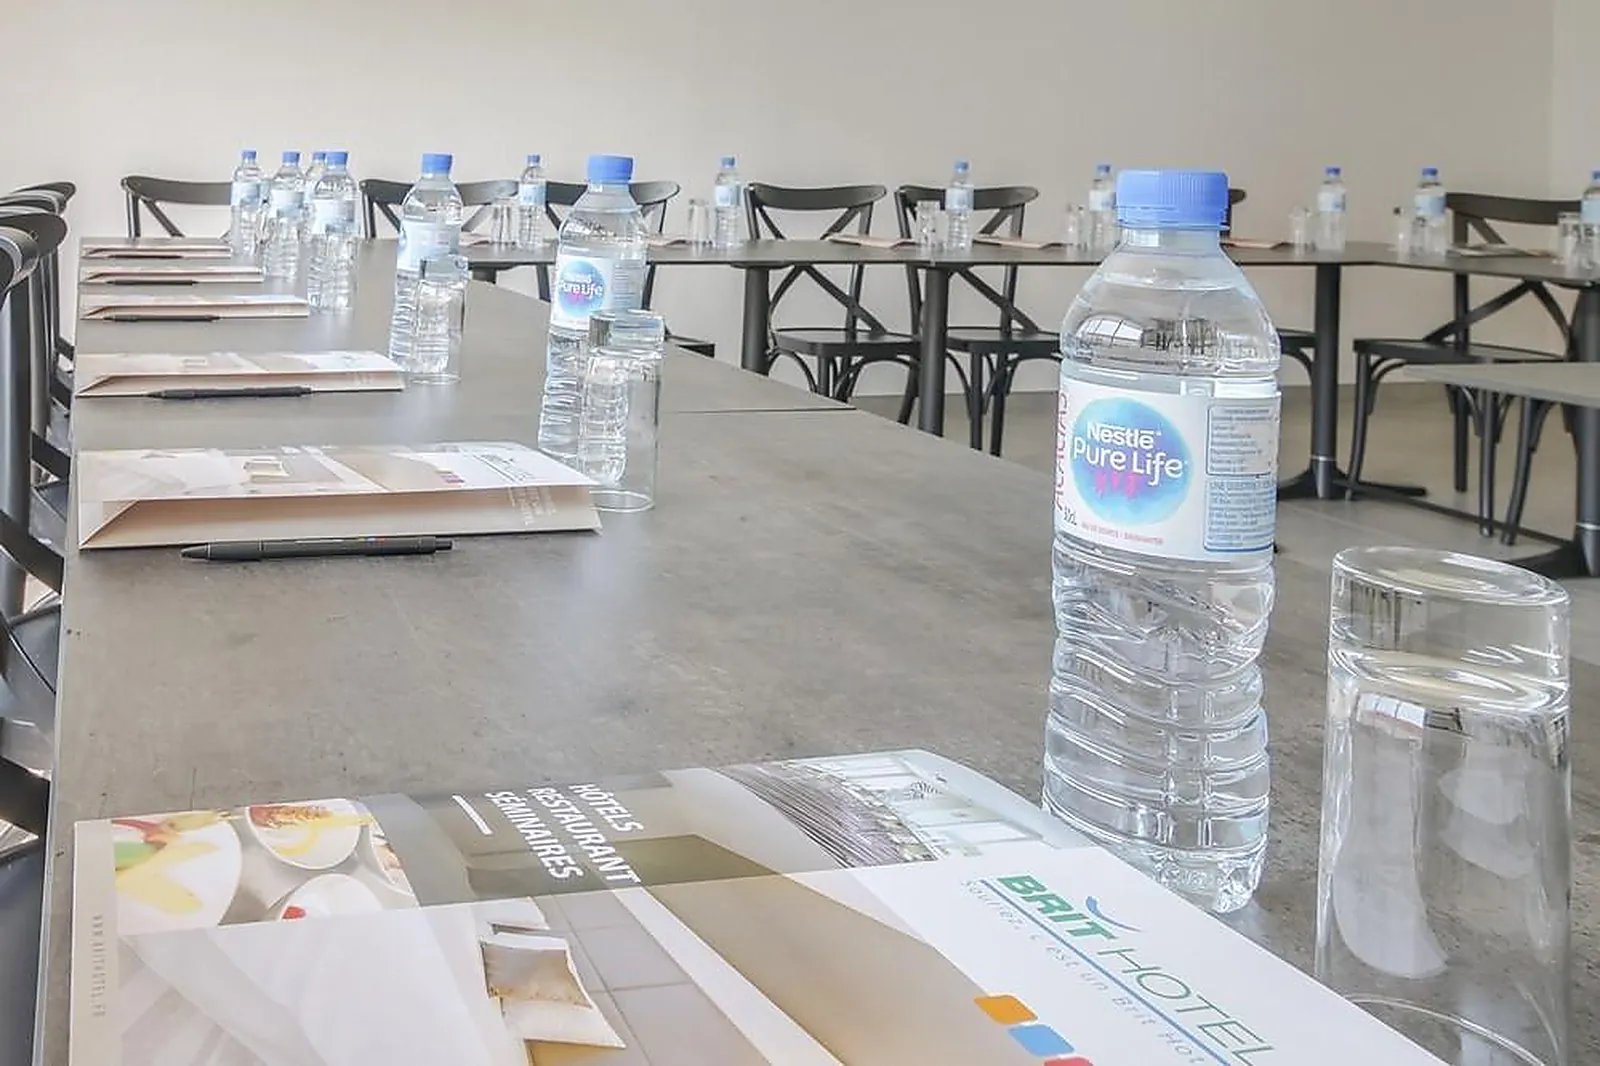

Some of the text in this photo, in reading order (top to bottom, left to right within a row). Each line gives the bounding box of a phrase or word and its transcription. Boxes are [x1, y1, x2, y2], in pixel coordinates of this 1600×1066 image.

[1073, 435, 1183, 486] Pure Life
[484, 790, 585, 880] SÉMINAIRES
[527, 786, 642, 885] RESTAURANT
[568, 783, 644, 833] HÔTELS
[997, 875, 1275, 1066] BRIT HOTEL
